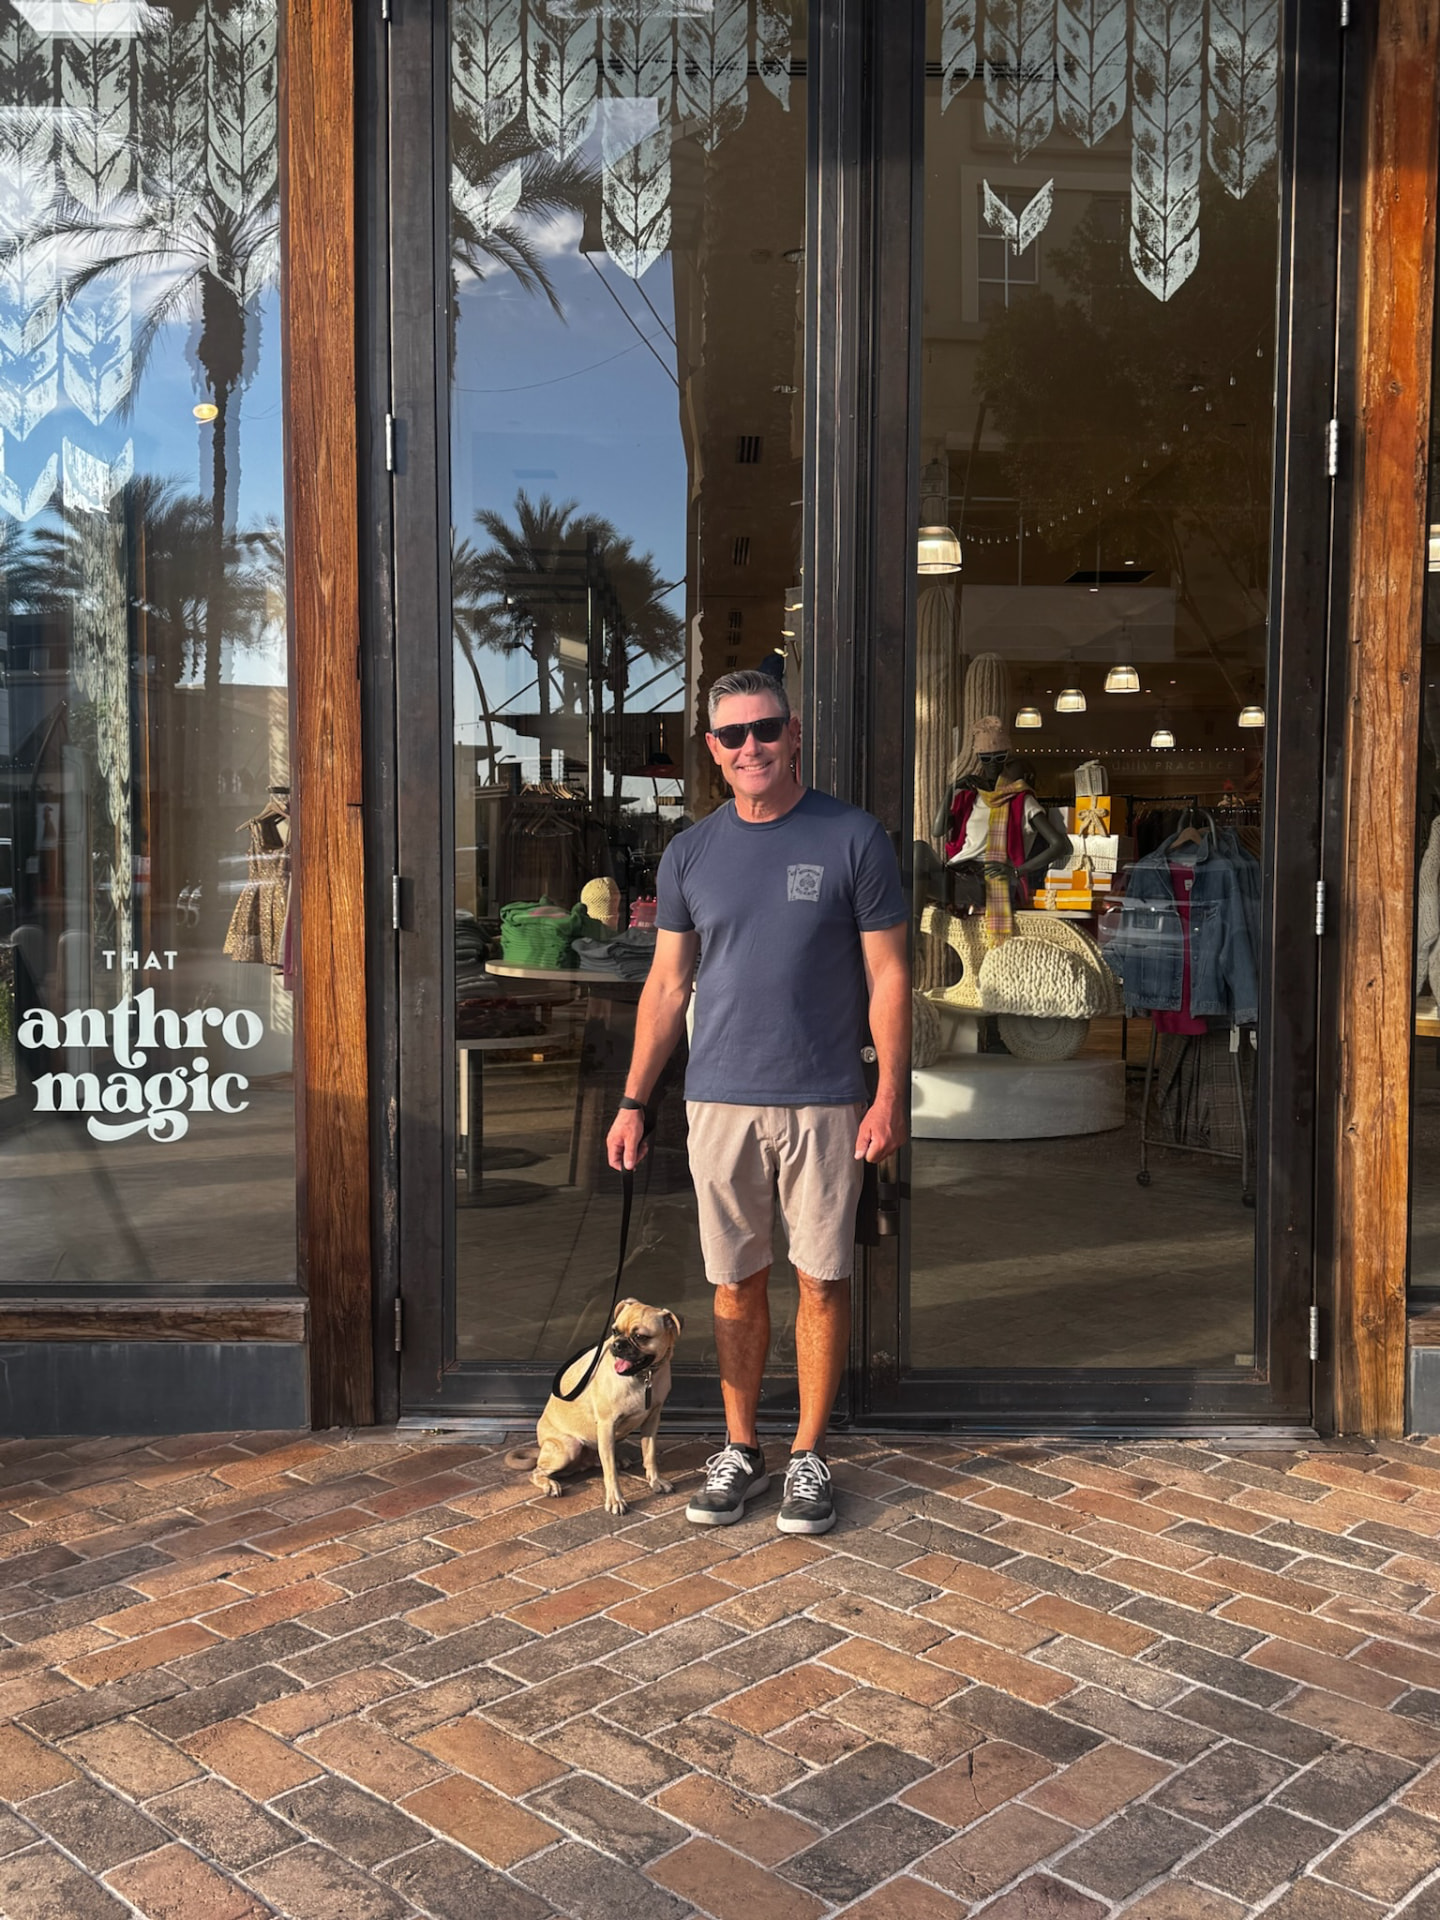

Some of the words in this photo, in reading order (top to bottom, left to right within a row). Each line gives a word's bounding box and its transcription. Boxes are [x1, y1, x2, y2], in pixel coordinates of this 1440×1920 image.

[1155, 760, 1234, 771] PRACTICE
[102, 951, 178, 970] THAT
[17, 987, 264, 1069] anthro
[32, 1056, 249, 1143] magic
